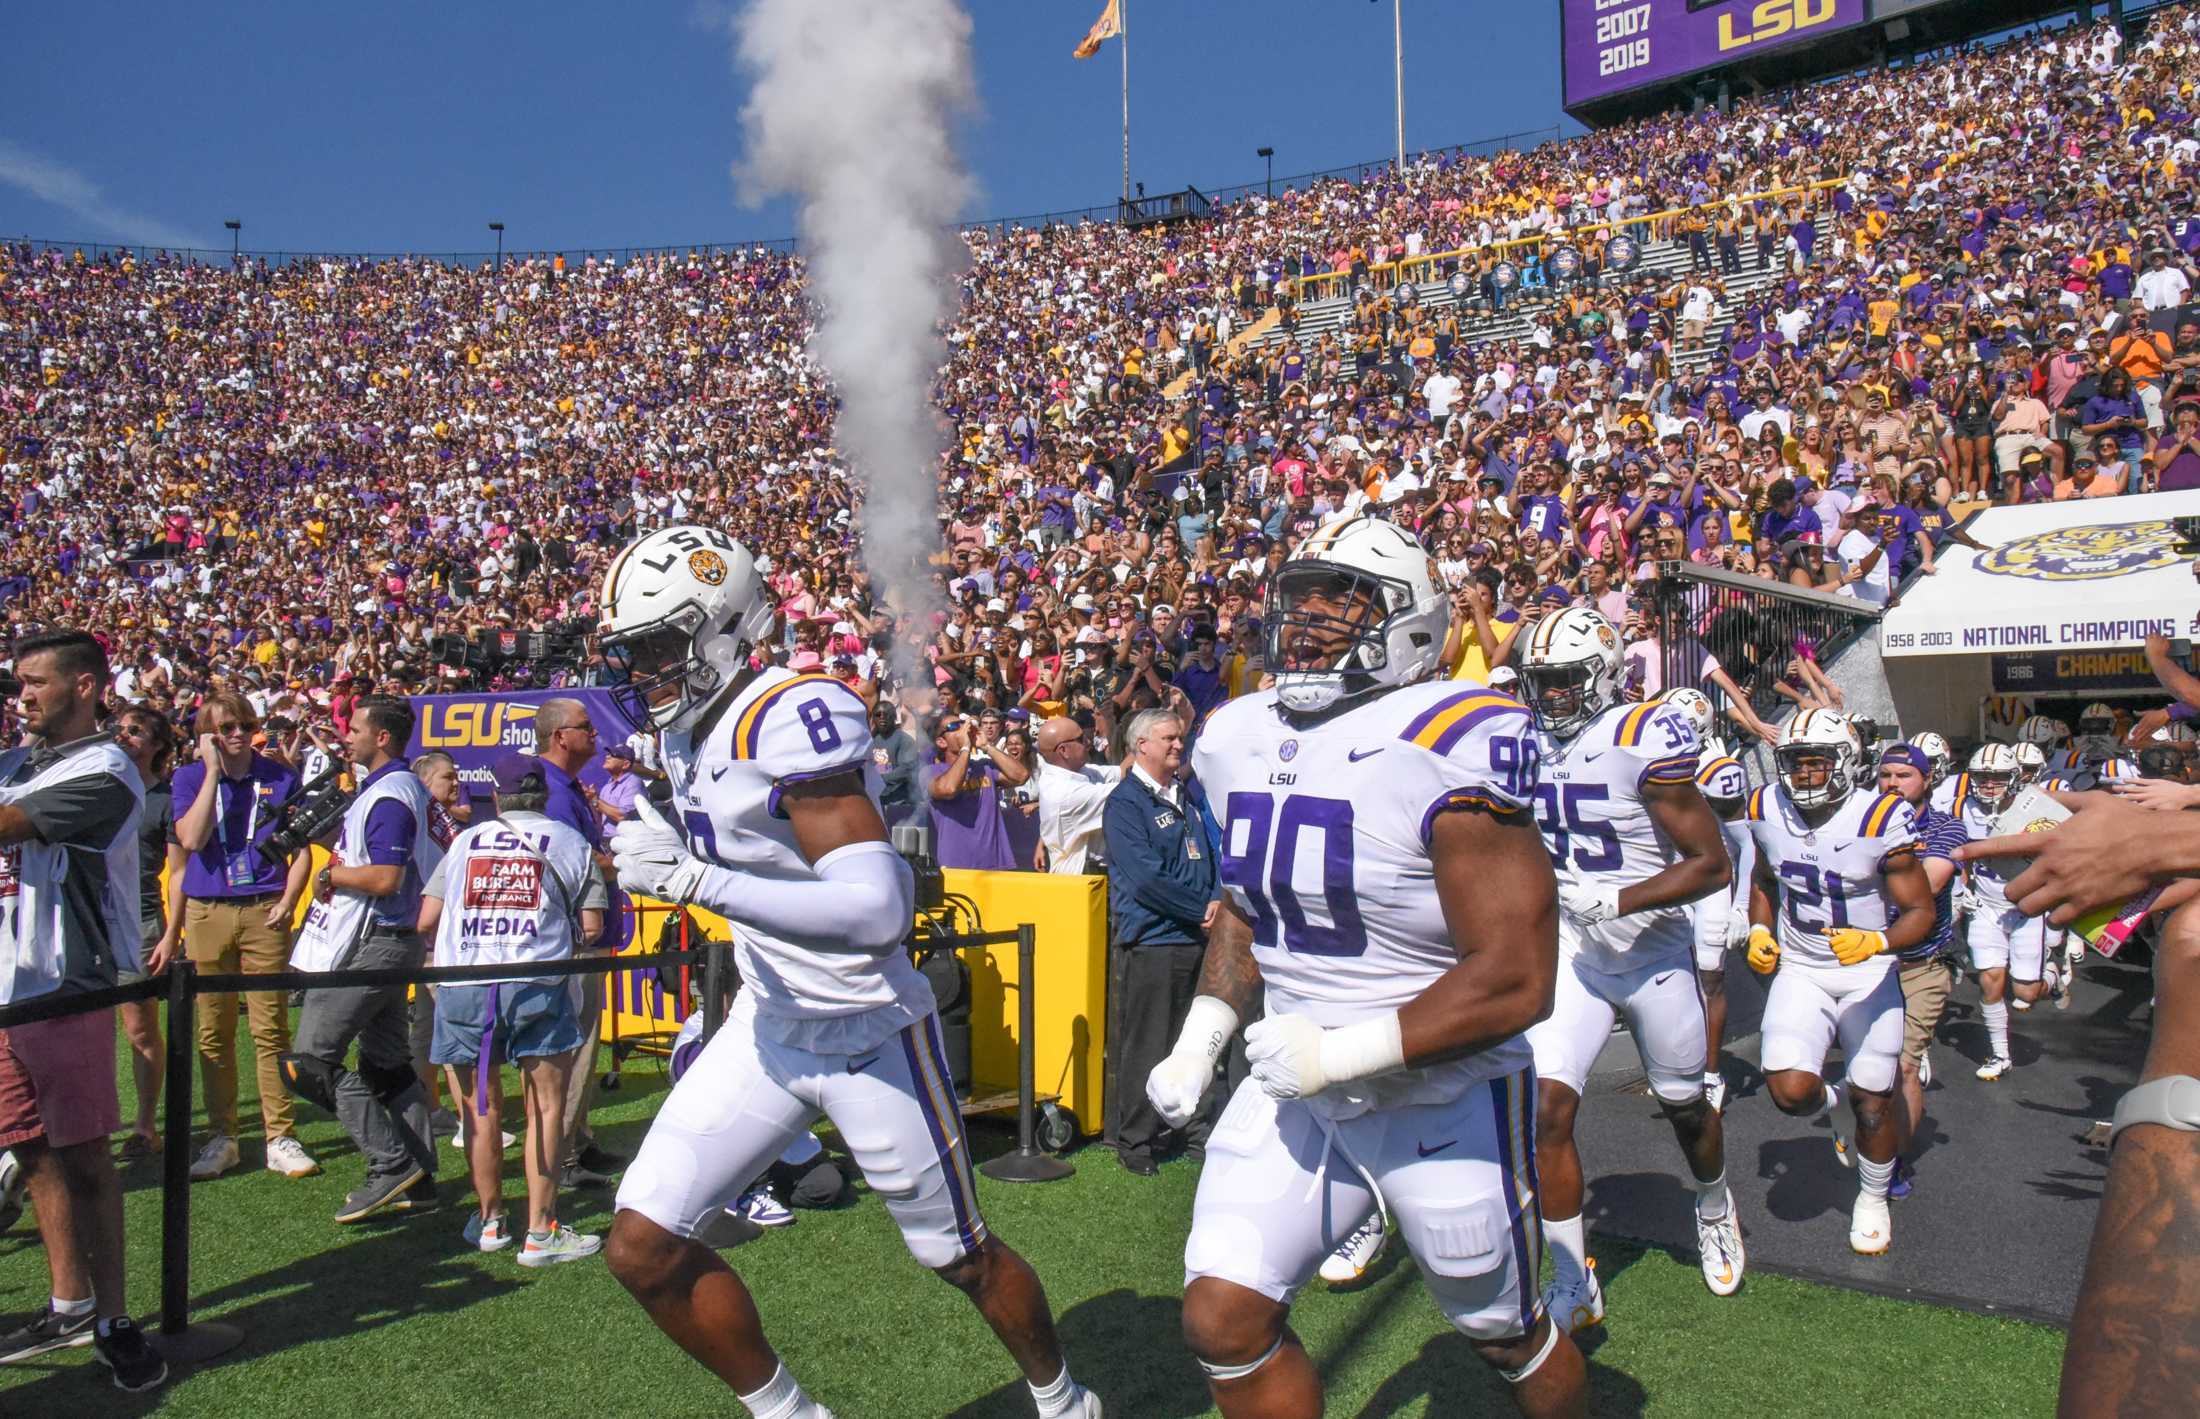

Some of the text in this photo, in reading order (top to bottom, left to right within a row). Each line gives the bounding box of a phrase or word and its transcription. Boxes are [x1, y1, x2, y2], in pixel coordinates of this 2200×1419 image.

[1597, 2, 1650, 44] 2007
[1718, 0, 1835, 51] LSU
[1600, 38, 1650, 77] 2019
[1530, 506, 1547, 532] 9
[641, 529, 734, 574] LSU
[1569, 611, 1605, 636] LS
[1886, 633, 1914, 648] 1958
[1920, 631, 1953, 646] 2003
[1963, 624, 2053, 648] NATIONAL
[2060, 618, 2176, 643] CHAMPIONS
[2007, 665, 2034, 680] 1986
[2056, 650, 2154, 678] CHAMPIO
[422, 702, 506, 747] LSU
[797, 697, 842, 755] 8
[1654, 713, 1693, 750] 35
[310, 756, 323, 775] 9
[454, 764, 494, 782] anatic
[1268, 772, 1297, 785] LSU
[1489, 735, 1540, 798] 90
[1553, 772, 1570, 780] LSU
[1720, 771, 1742, 796] 27
[1533, 783, 1624, 872] 35
[470, 831, 550, 853] LSU
[492, 863, 535, 876] FARM
[1800, 853, 1819, 862] LSU
[472, 876, 535, 891] BUREAU
[1220, 792, 1368, 956] 90
[481, 893, 533, 903] INSURANCE
[1780, 860, 1849, 936] 21
[461, 917, 538, 938] MEDIA
